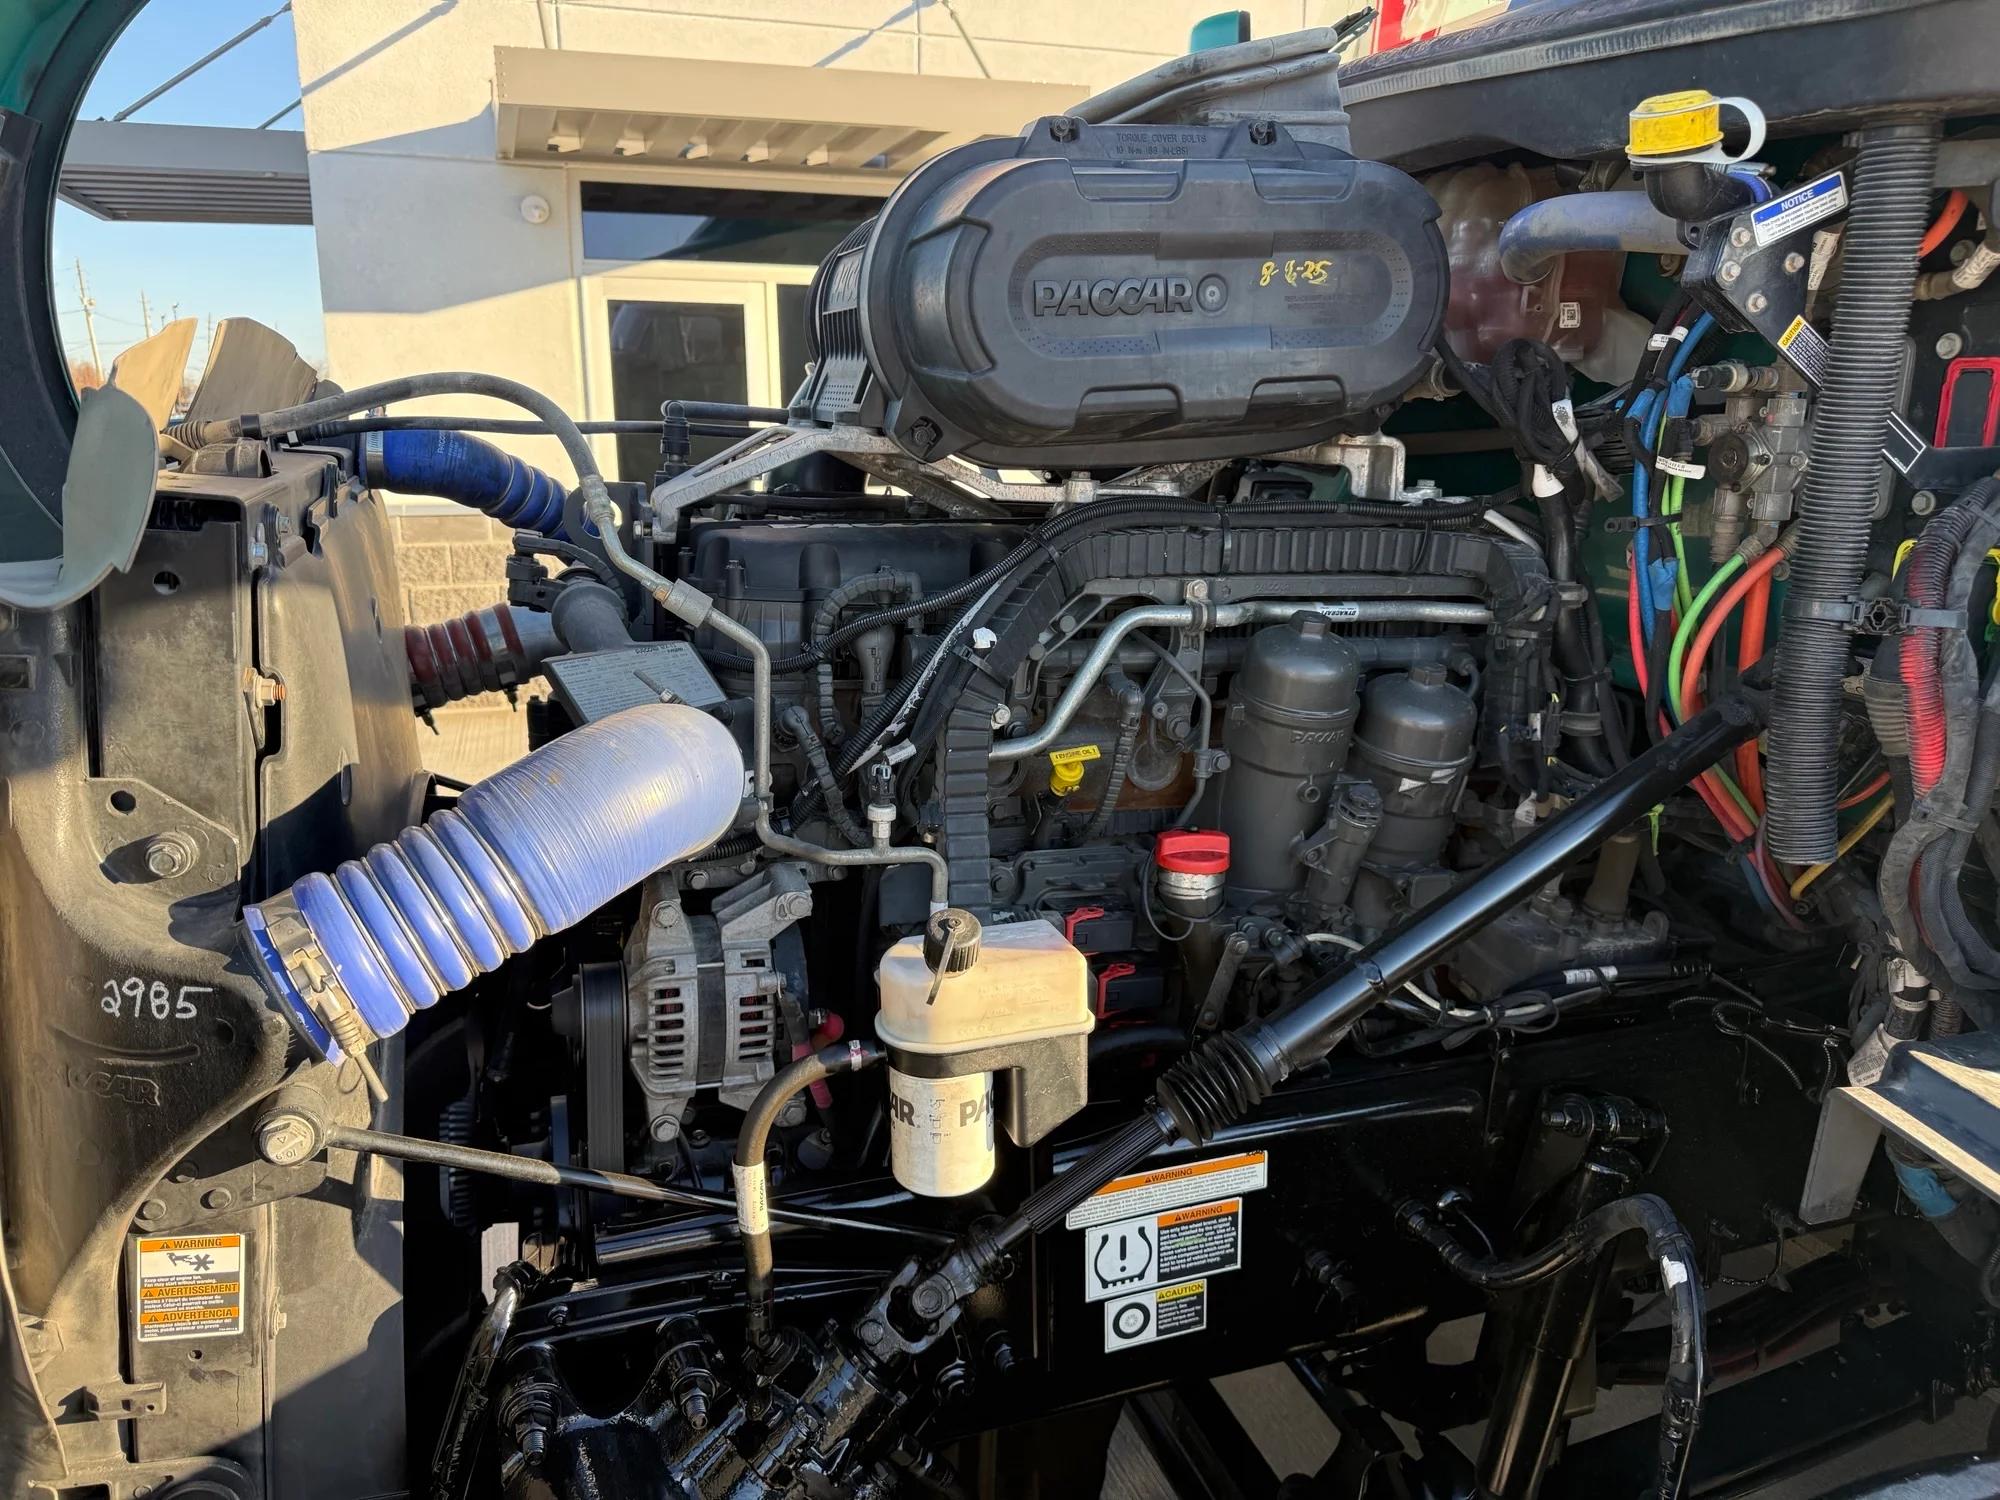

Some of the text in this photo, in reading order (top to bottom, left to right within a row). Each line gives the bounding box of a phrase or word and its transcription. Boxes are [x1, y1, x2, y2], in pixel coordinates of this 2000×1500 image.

[1151, 133, 1177, 143] COVER
[1181, 134, 1207, 143] BOLTS
[1781, 188, 1814, 211] NOTICE
[1033, 276, 1193, 317] PACCAR
[1782, 320, 1802, 346] CAUTION
[101, 977, 213, 1019] 2985
[1151, 1167, 1193, 1182] WARNING
[1182, 1206, 1223, 1219] WARNING
[174, 1238, 221, 1248] WARNING
[158, 1283, 236, 1296] AVERTISSEMENT
[1166, 1284, 1203, 1297] CAUTION
[163, 1309, 231, 1320] ADVERTENCIA
